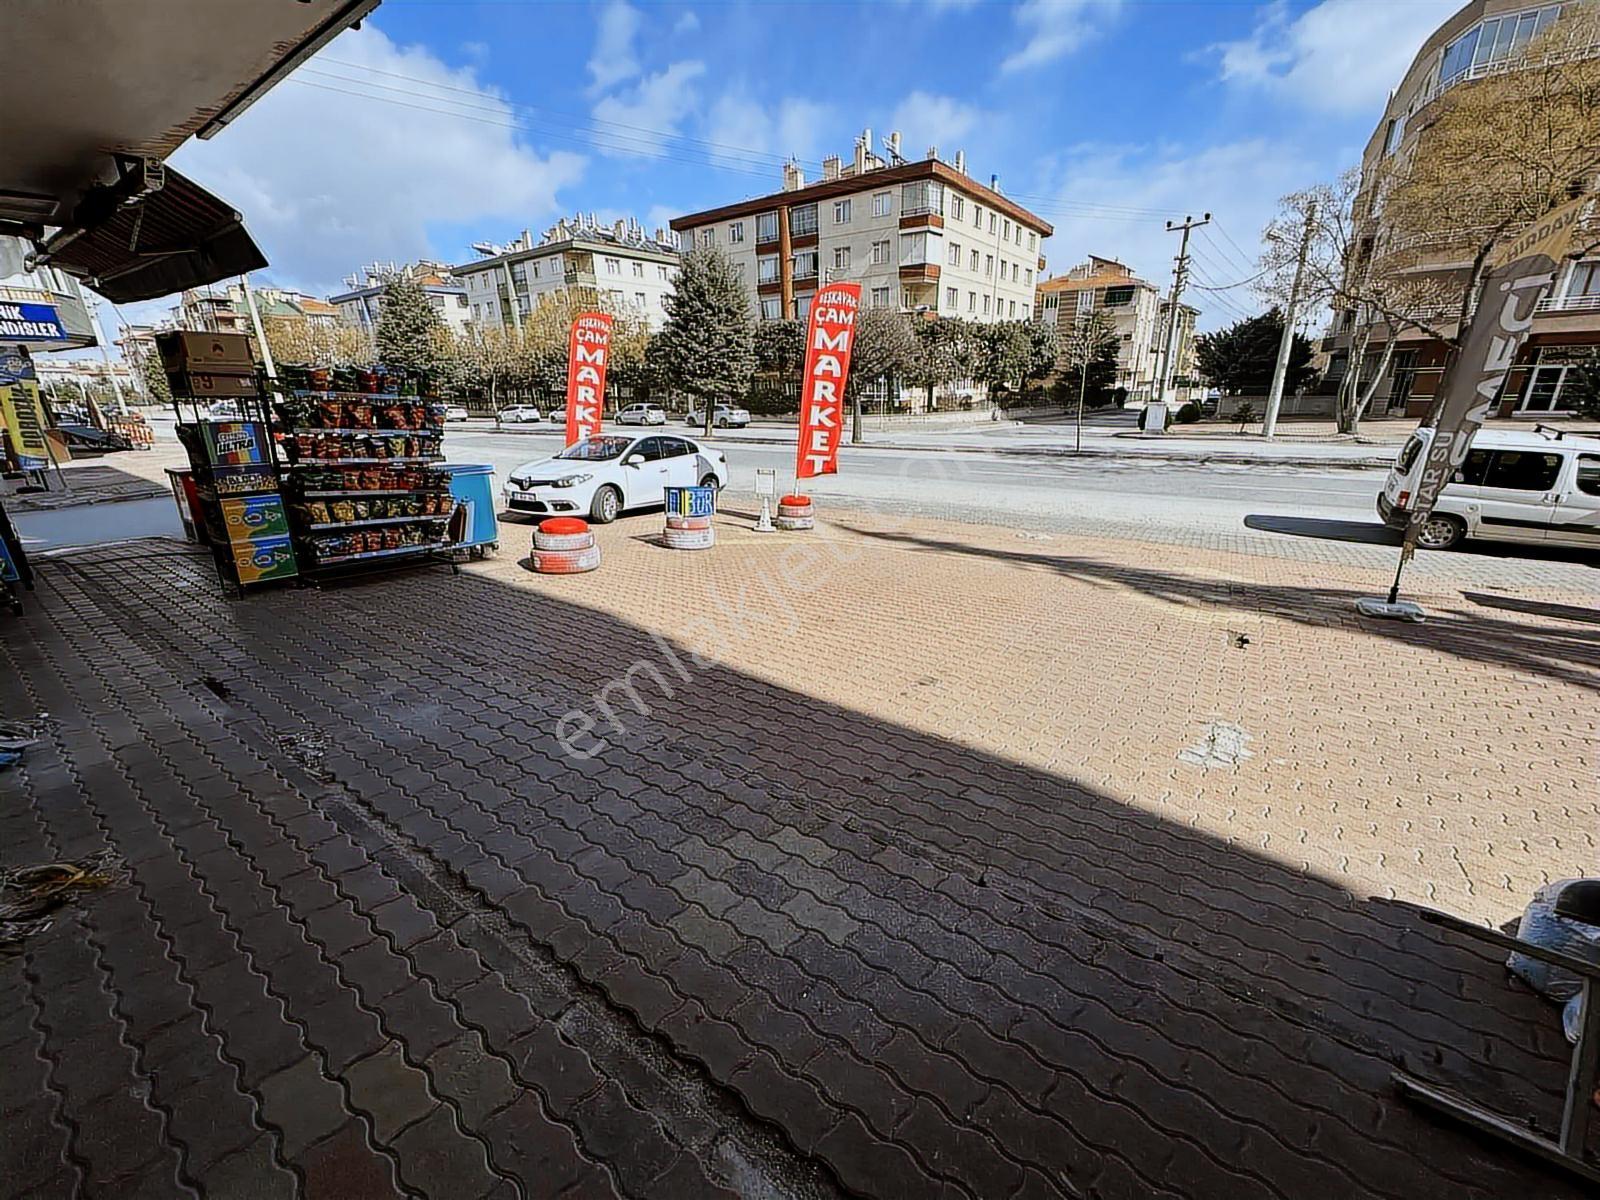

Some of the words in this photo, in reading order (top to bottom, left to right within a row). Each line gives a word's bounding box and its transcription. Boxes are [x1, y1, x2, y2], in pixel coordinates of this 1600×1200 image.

[576, 328, 607, 345] ÇAM
[814, 306, 854, 326] ÇAM
[800, 327, 850, 475] MARKET
[1411, 468, 1442, 525] STAR
[1430, 432, 1455, 462] SU
